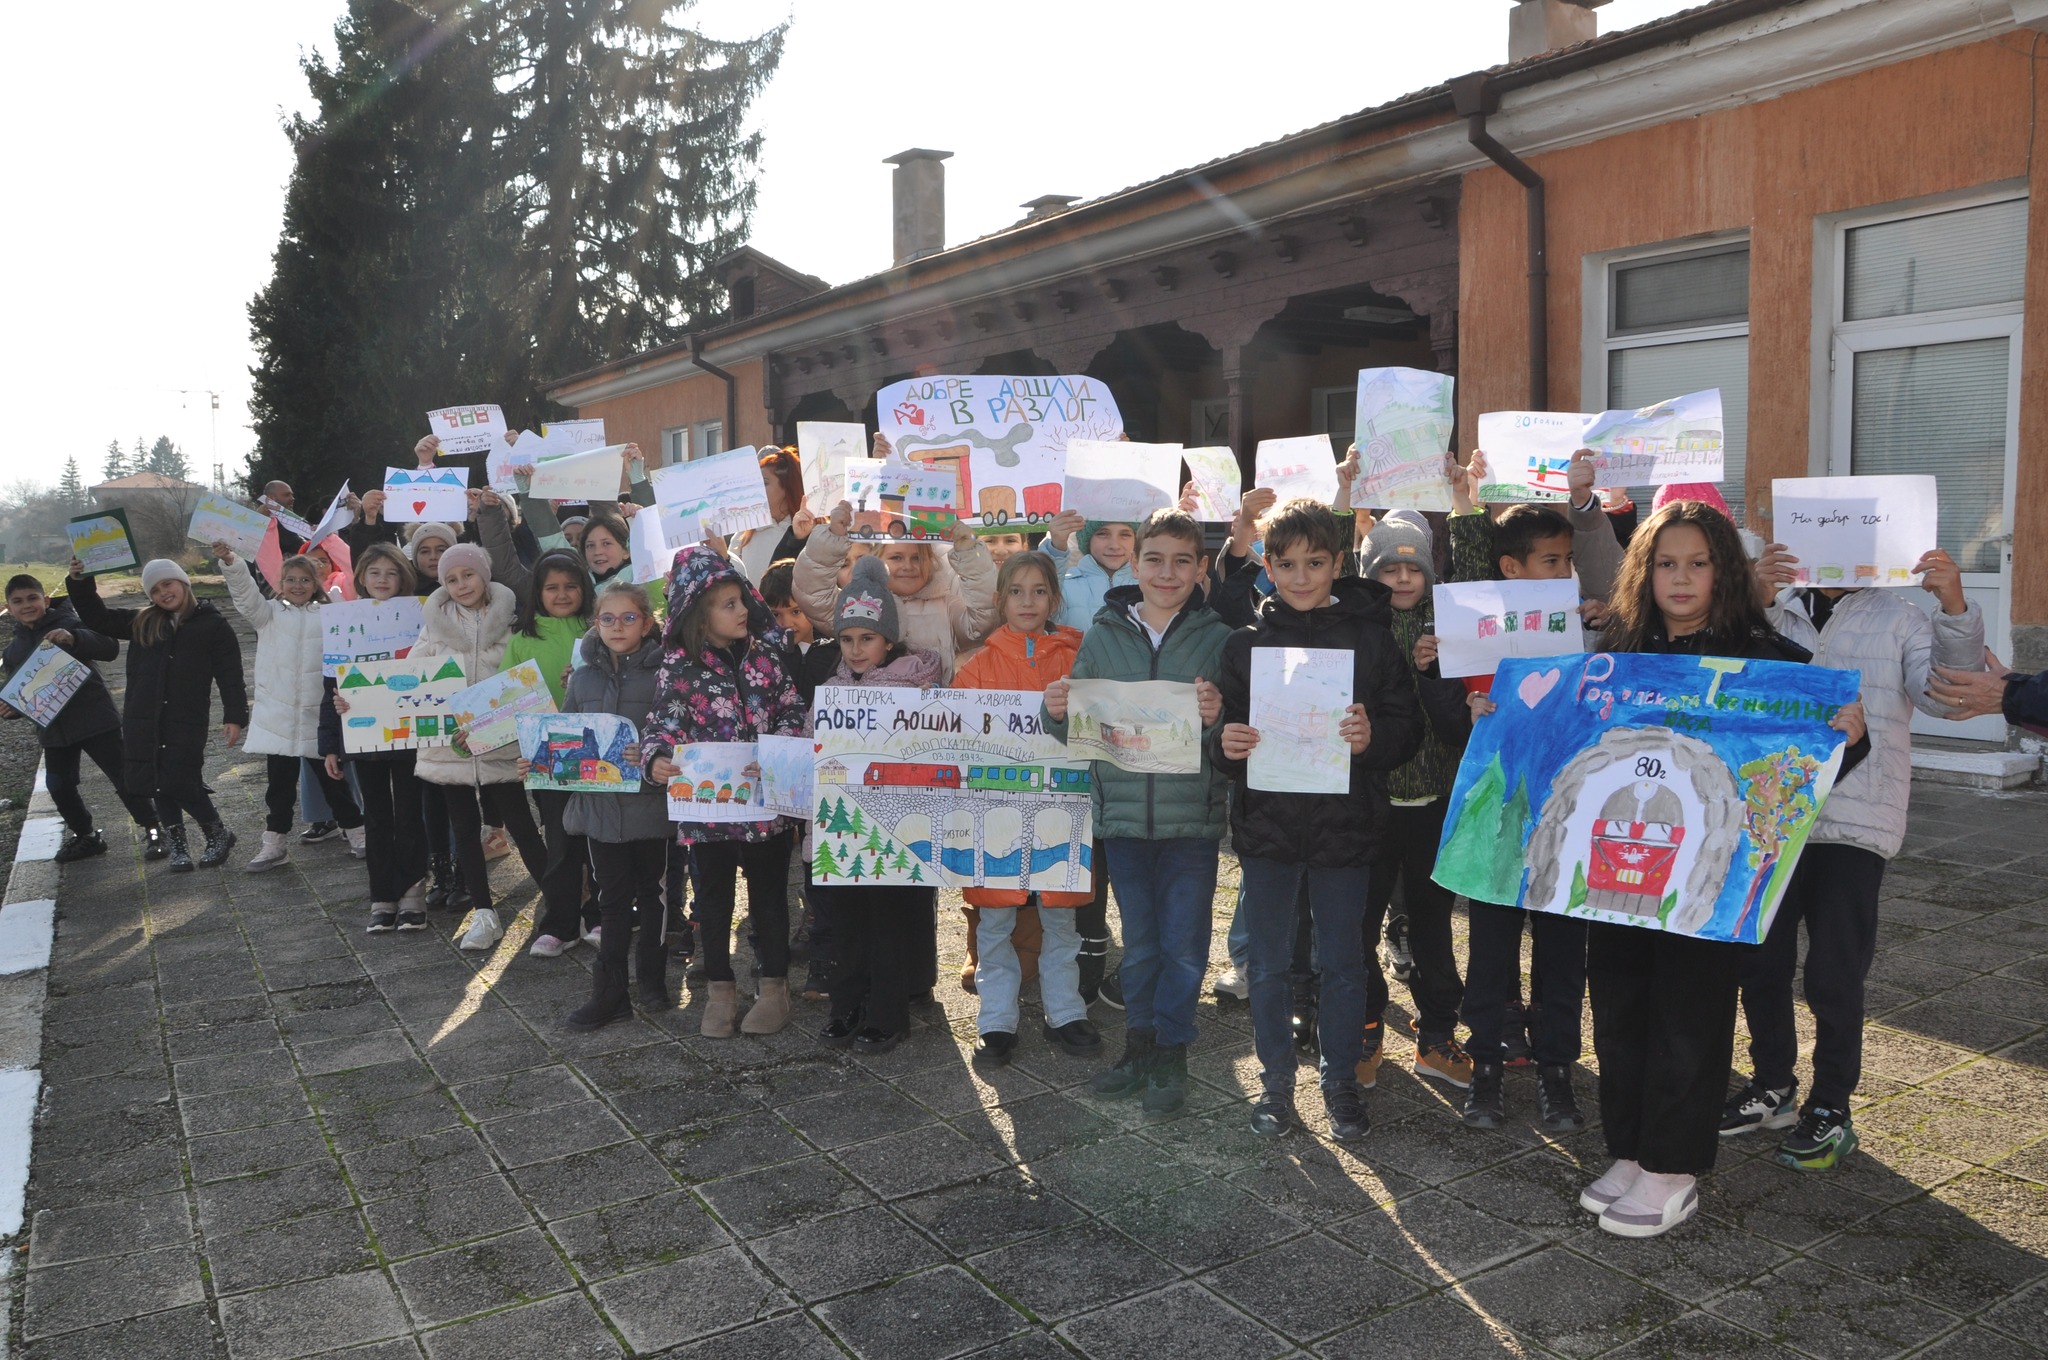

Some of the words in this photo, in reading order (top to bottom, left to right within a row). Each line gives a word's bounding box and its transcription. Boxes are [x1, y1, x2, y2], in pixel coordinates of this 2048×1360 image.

[905, 379, 974, 401] ДОБРЕ
[999, 377, 1091, 398] ДОШЛИ
[950, 399, 974, 425] В
[987, 396, 1097, 423] РАЗЛОГ
[1515, 415, 1531, 428] 80
[1791, 512, 1812, 525] На
[815, 708, 877, 730] ДОБРЕ
[893, 709, 962, 733] ДОШЛИ
[983, 713, 992, 735] В
